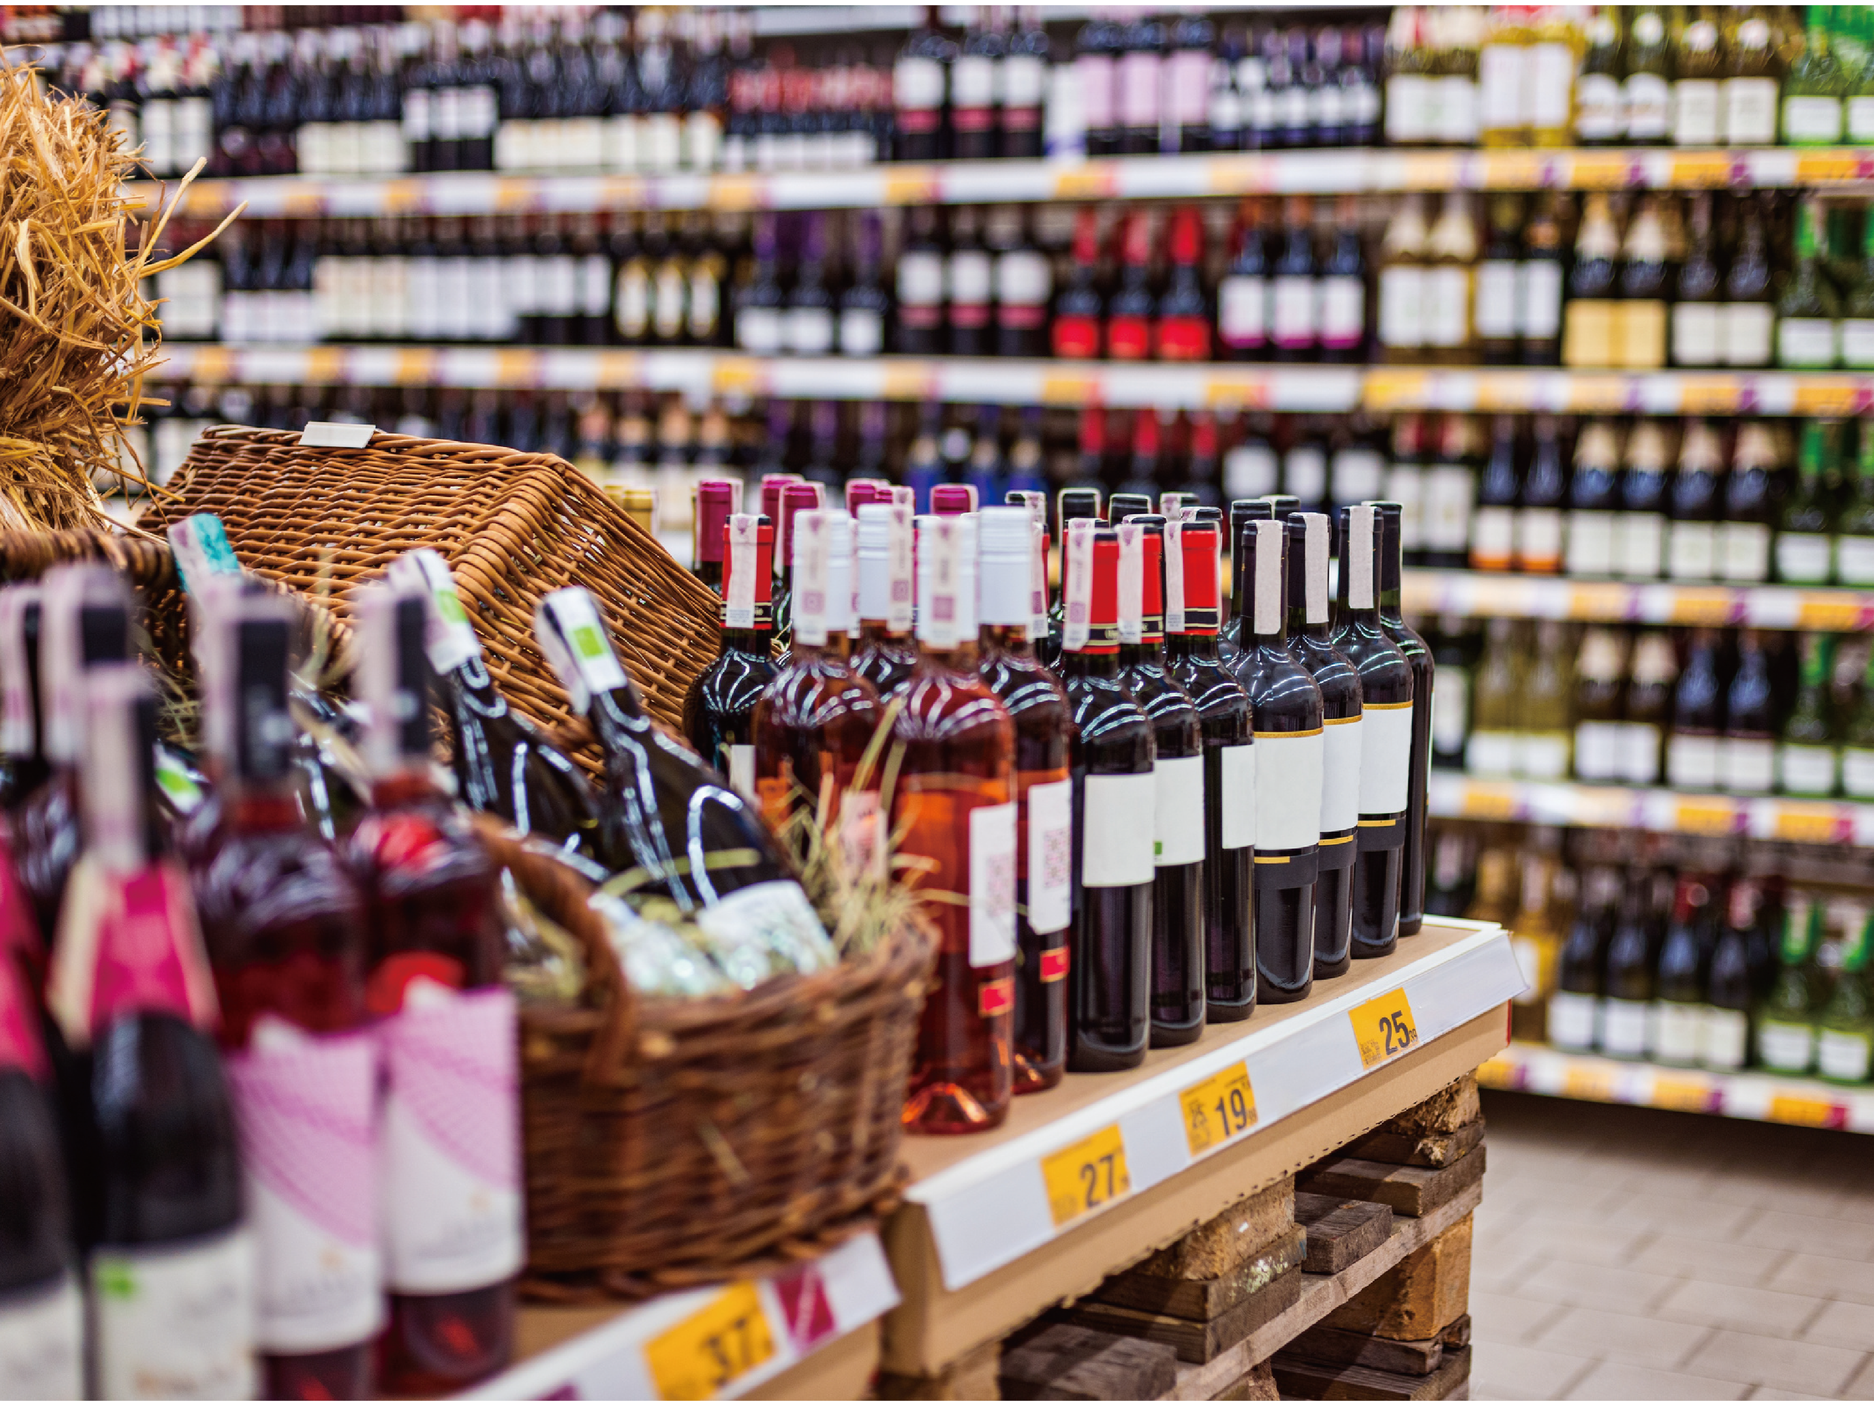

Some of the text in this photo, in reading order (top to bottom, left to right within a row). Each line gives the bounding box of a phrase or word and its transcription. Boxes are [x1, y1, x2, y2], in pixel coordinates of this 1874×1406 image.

[1379, 1010, 1410, 1055] 25
[1215, 1088, 1247, 1136] 19
[1080, 1153, 1114, 1208] 27
